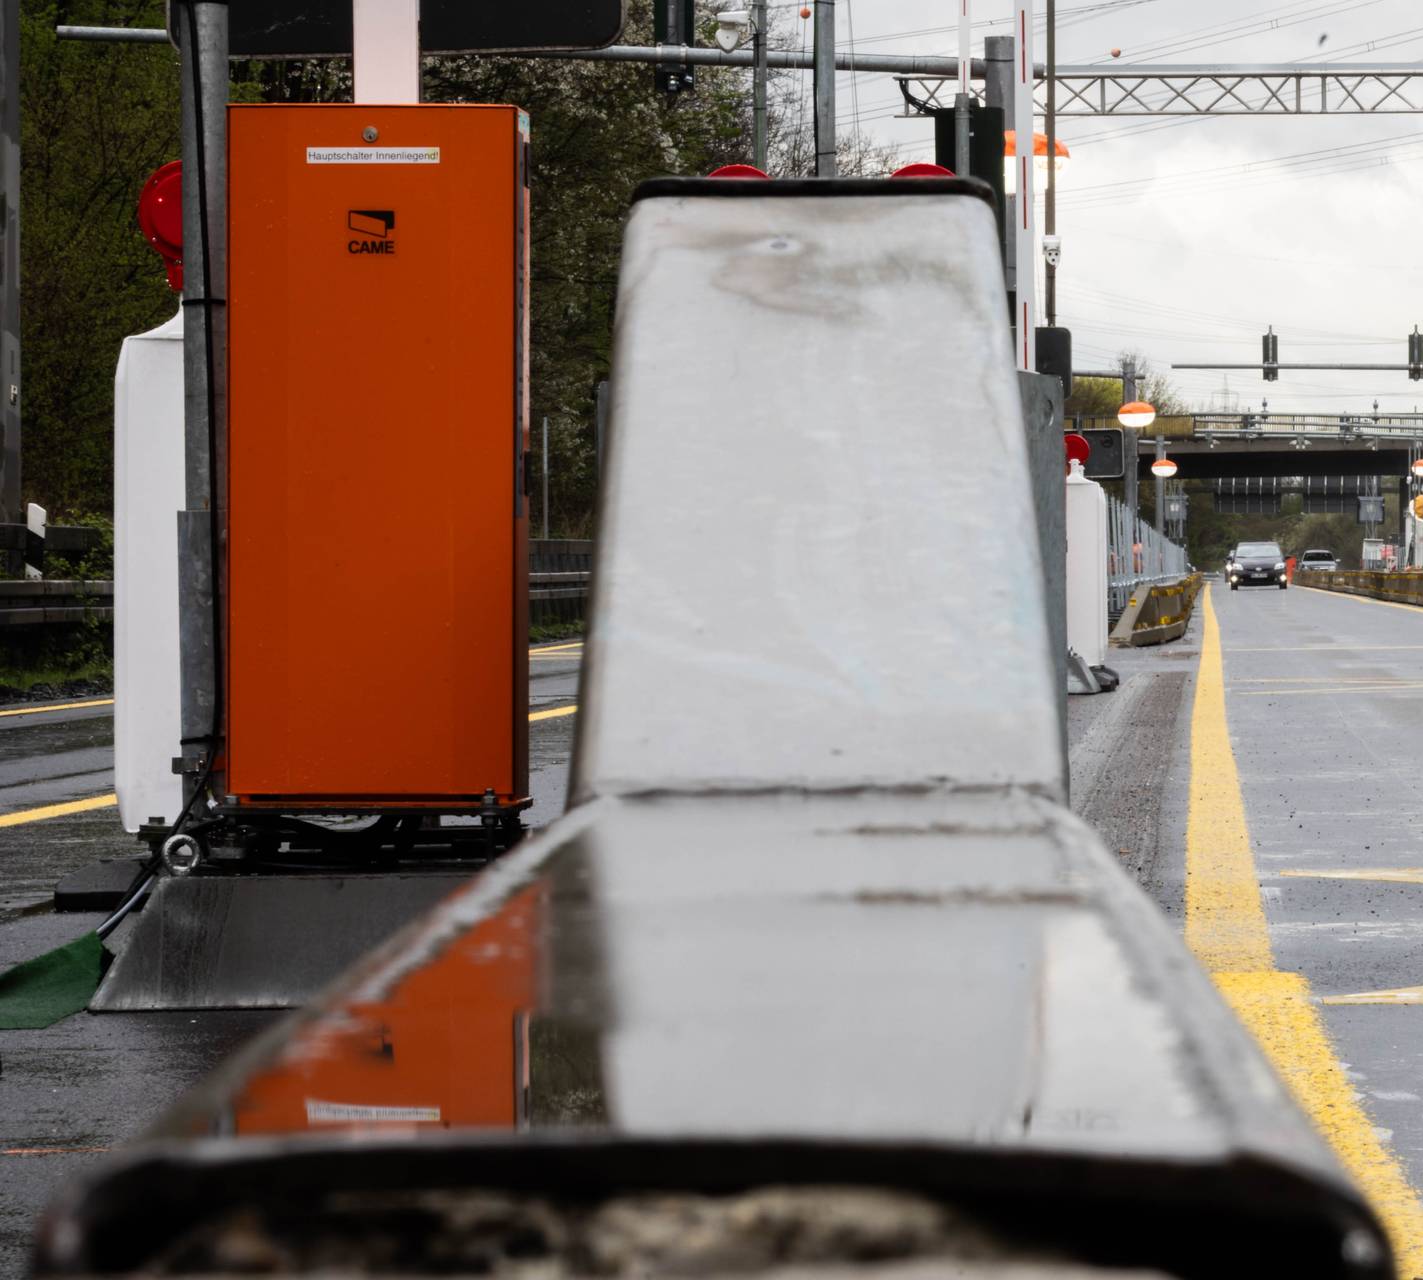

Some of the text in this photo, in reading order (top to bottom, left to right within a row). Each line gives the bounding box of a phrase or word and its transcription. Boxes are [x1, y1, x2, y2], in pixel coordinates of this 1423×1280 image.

[308, 151, 439, 162] Hauptschalter Innenliegend!
[348, 240, 395, 254] CAME
